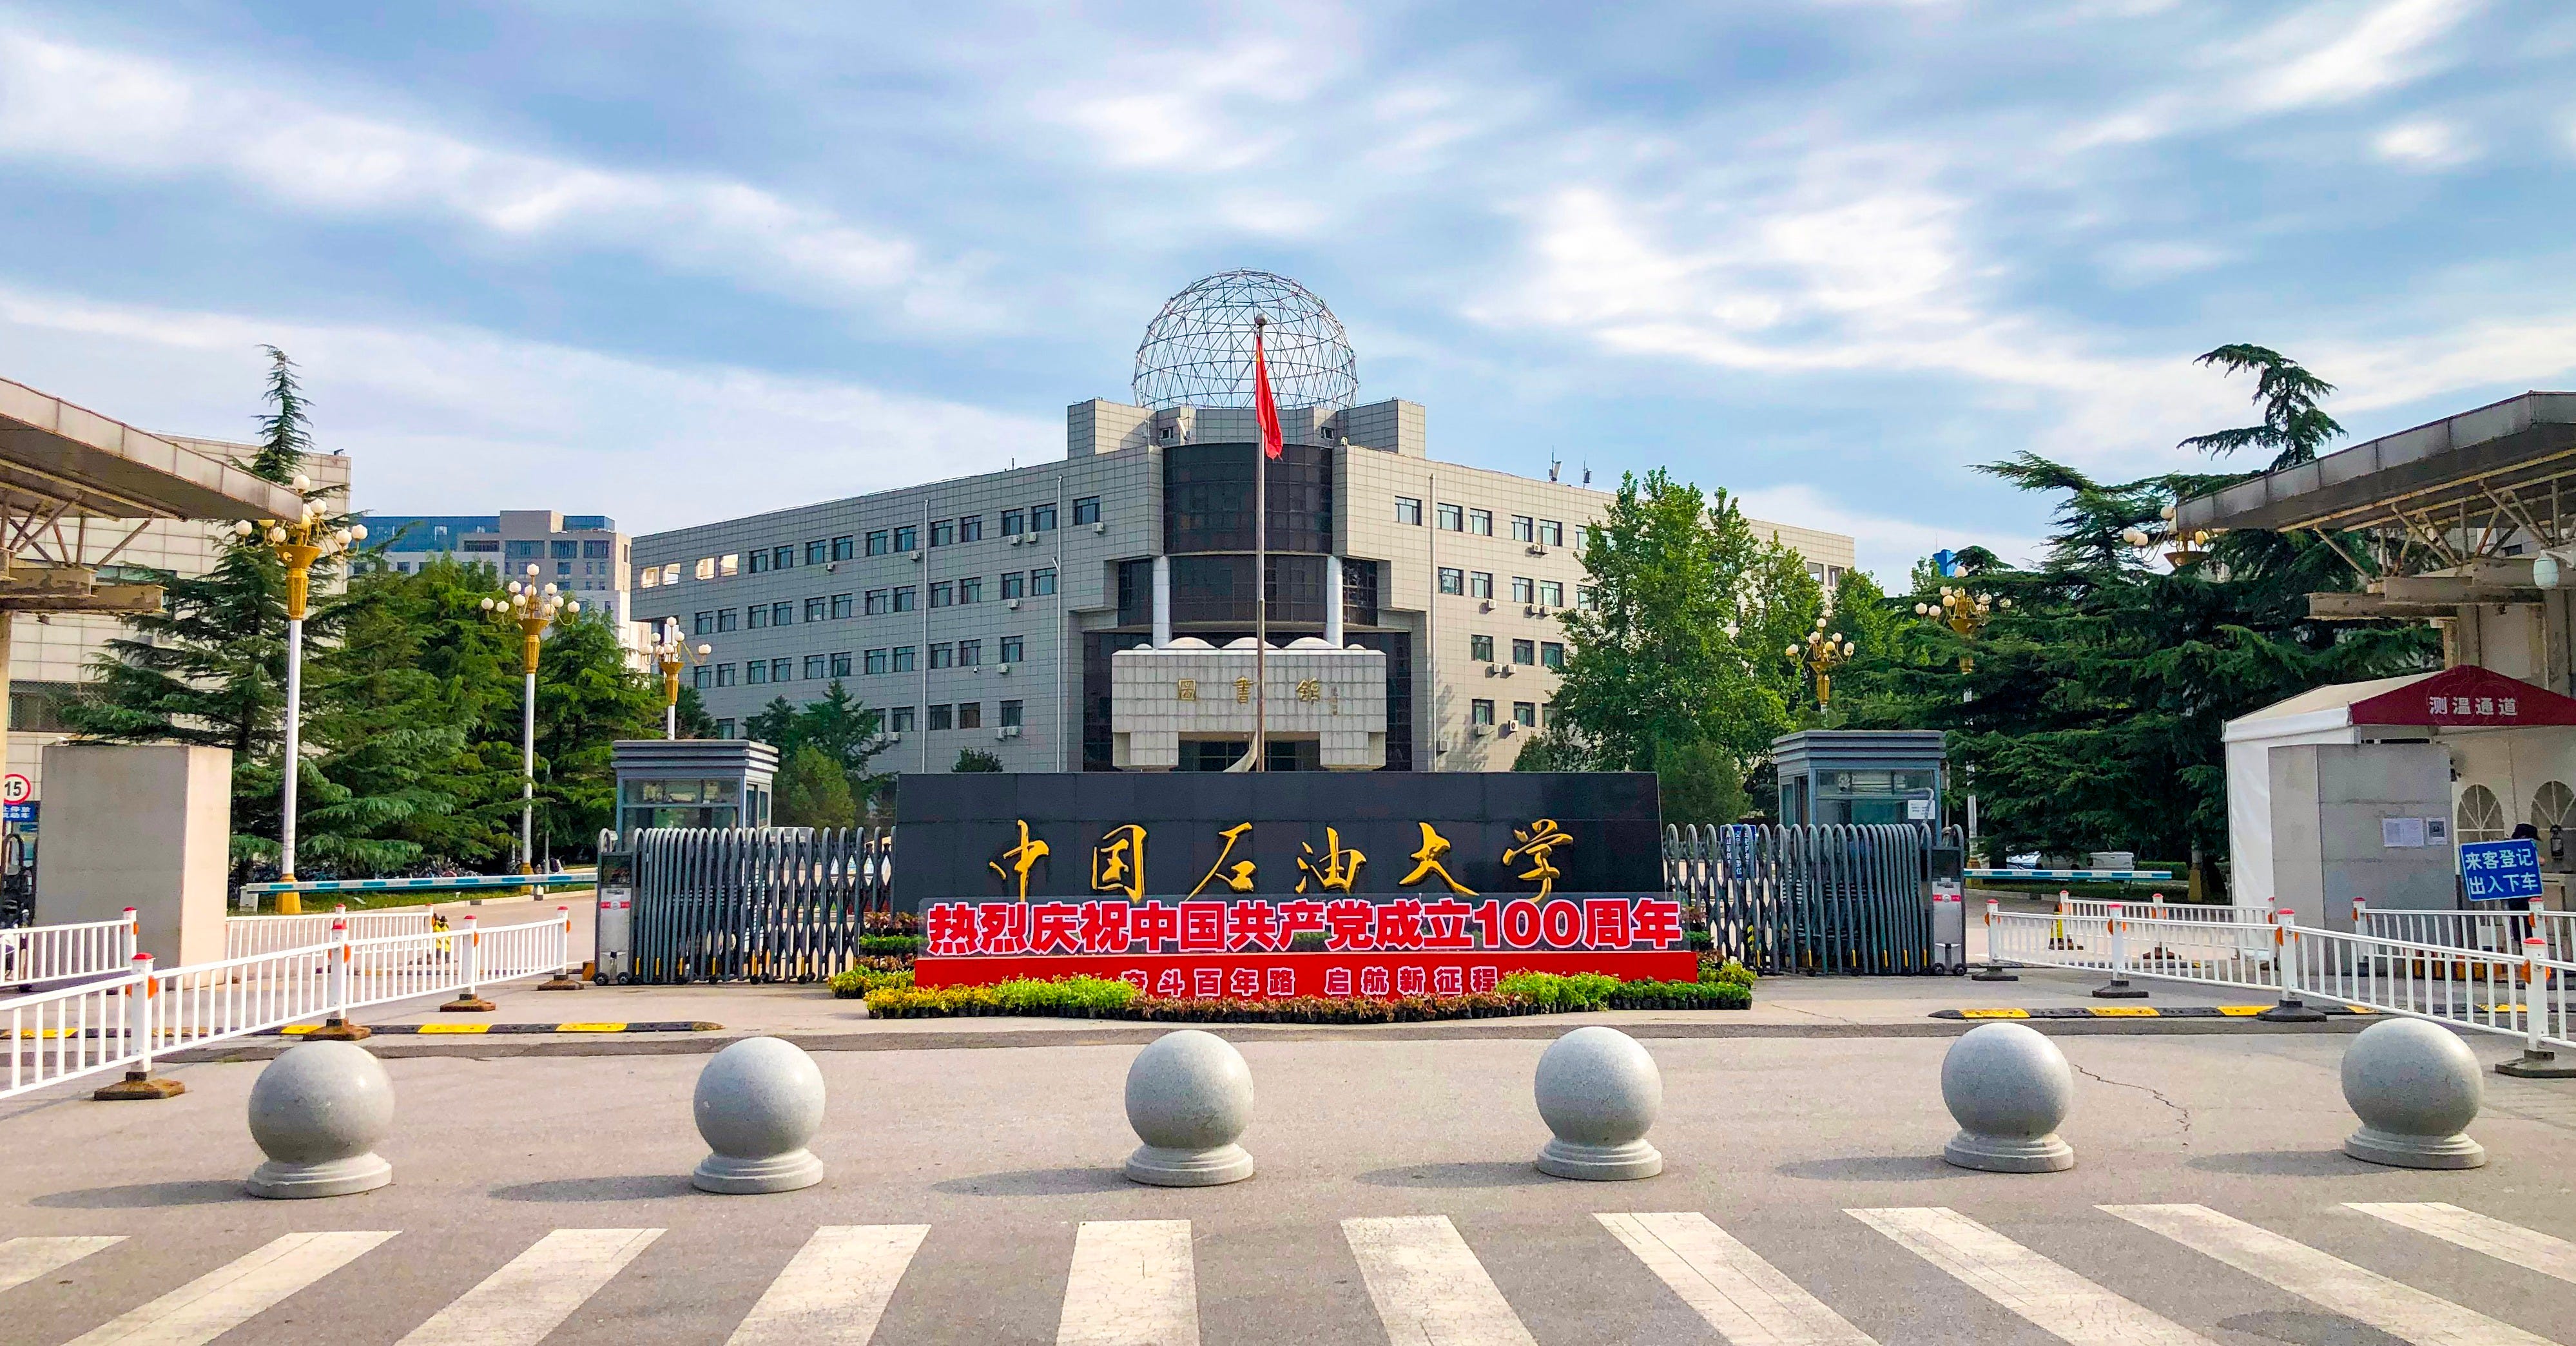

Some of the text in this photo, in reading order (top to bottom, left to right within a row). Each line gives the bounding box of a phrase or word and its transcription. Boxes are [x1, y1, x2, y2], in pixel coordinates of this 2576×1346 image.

[5, 781, 21, 796] 15
[989, 818, 1574, 903] 中国石油大学
[2465, 848, 2533, 870] 来客登记
[2469, 872, 2538, 895] 出入下车
[927, 898, 1683, 955] 热烈庆祝中国共产党成立100周年
[1325, 965, 1498, 996] 启航新征程
